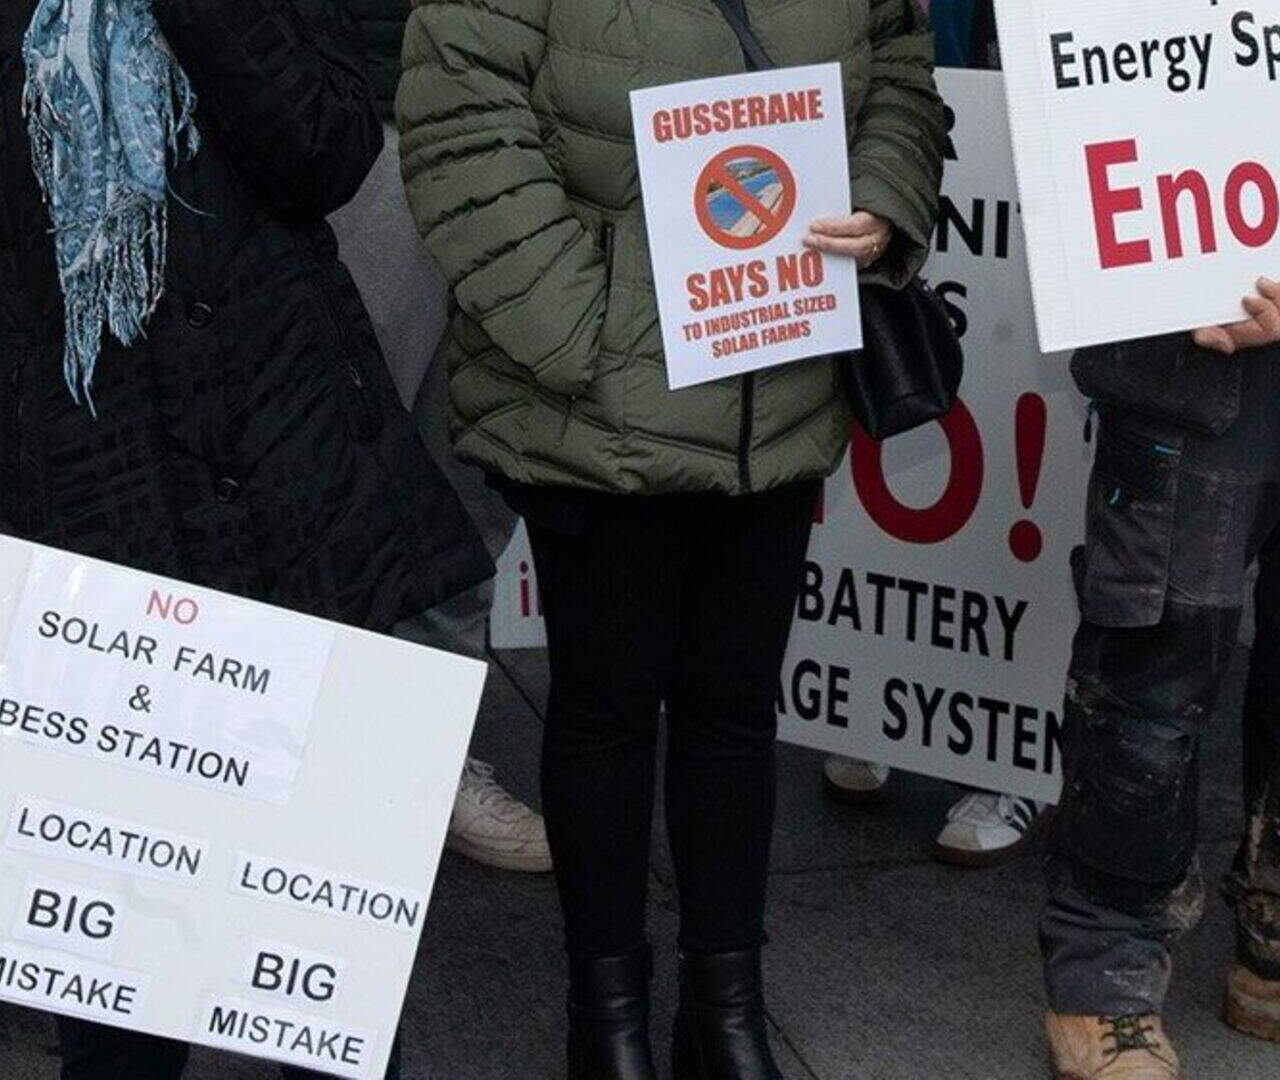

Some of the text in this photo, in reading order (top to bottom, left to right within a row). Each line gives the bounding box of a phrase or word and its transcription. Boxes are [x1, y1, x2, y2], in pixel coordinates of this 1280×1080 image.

[1050, 32, 1212, 93] Energy
[653, 89, 824, 143] GUSSERANE
[686, 250, 825, 312] SAYS NO
[682, 294, 837, 342] TO INDUSTRIAL SIZED
[712, 321, 812, 359] SOLAR FARMS
[146, 589, 199, 625] NO
[797, 561, 1028, 661] BATTERY
[38, 610, 270, 695] SOLAR FARM
[128, 684, 154, 714] &
[97, 725, 250, 788] STATION
[18, 807, 201, 875] LOCATION
[26, 888, 116, 940] BIG
[241, 861, 419, 928] LOCATION
[250, 951, 337, 1003] BIG
[208, 1006, 364, 1065] MISTAKE
